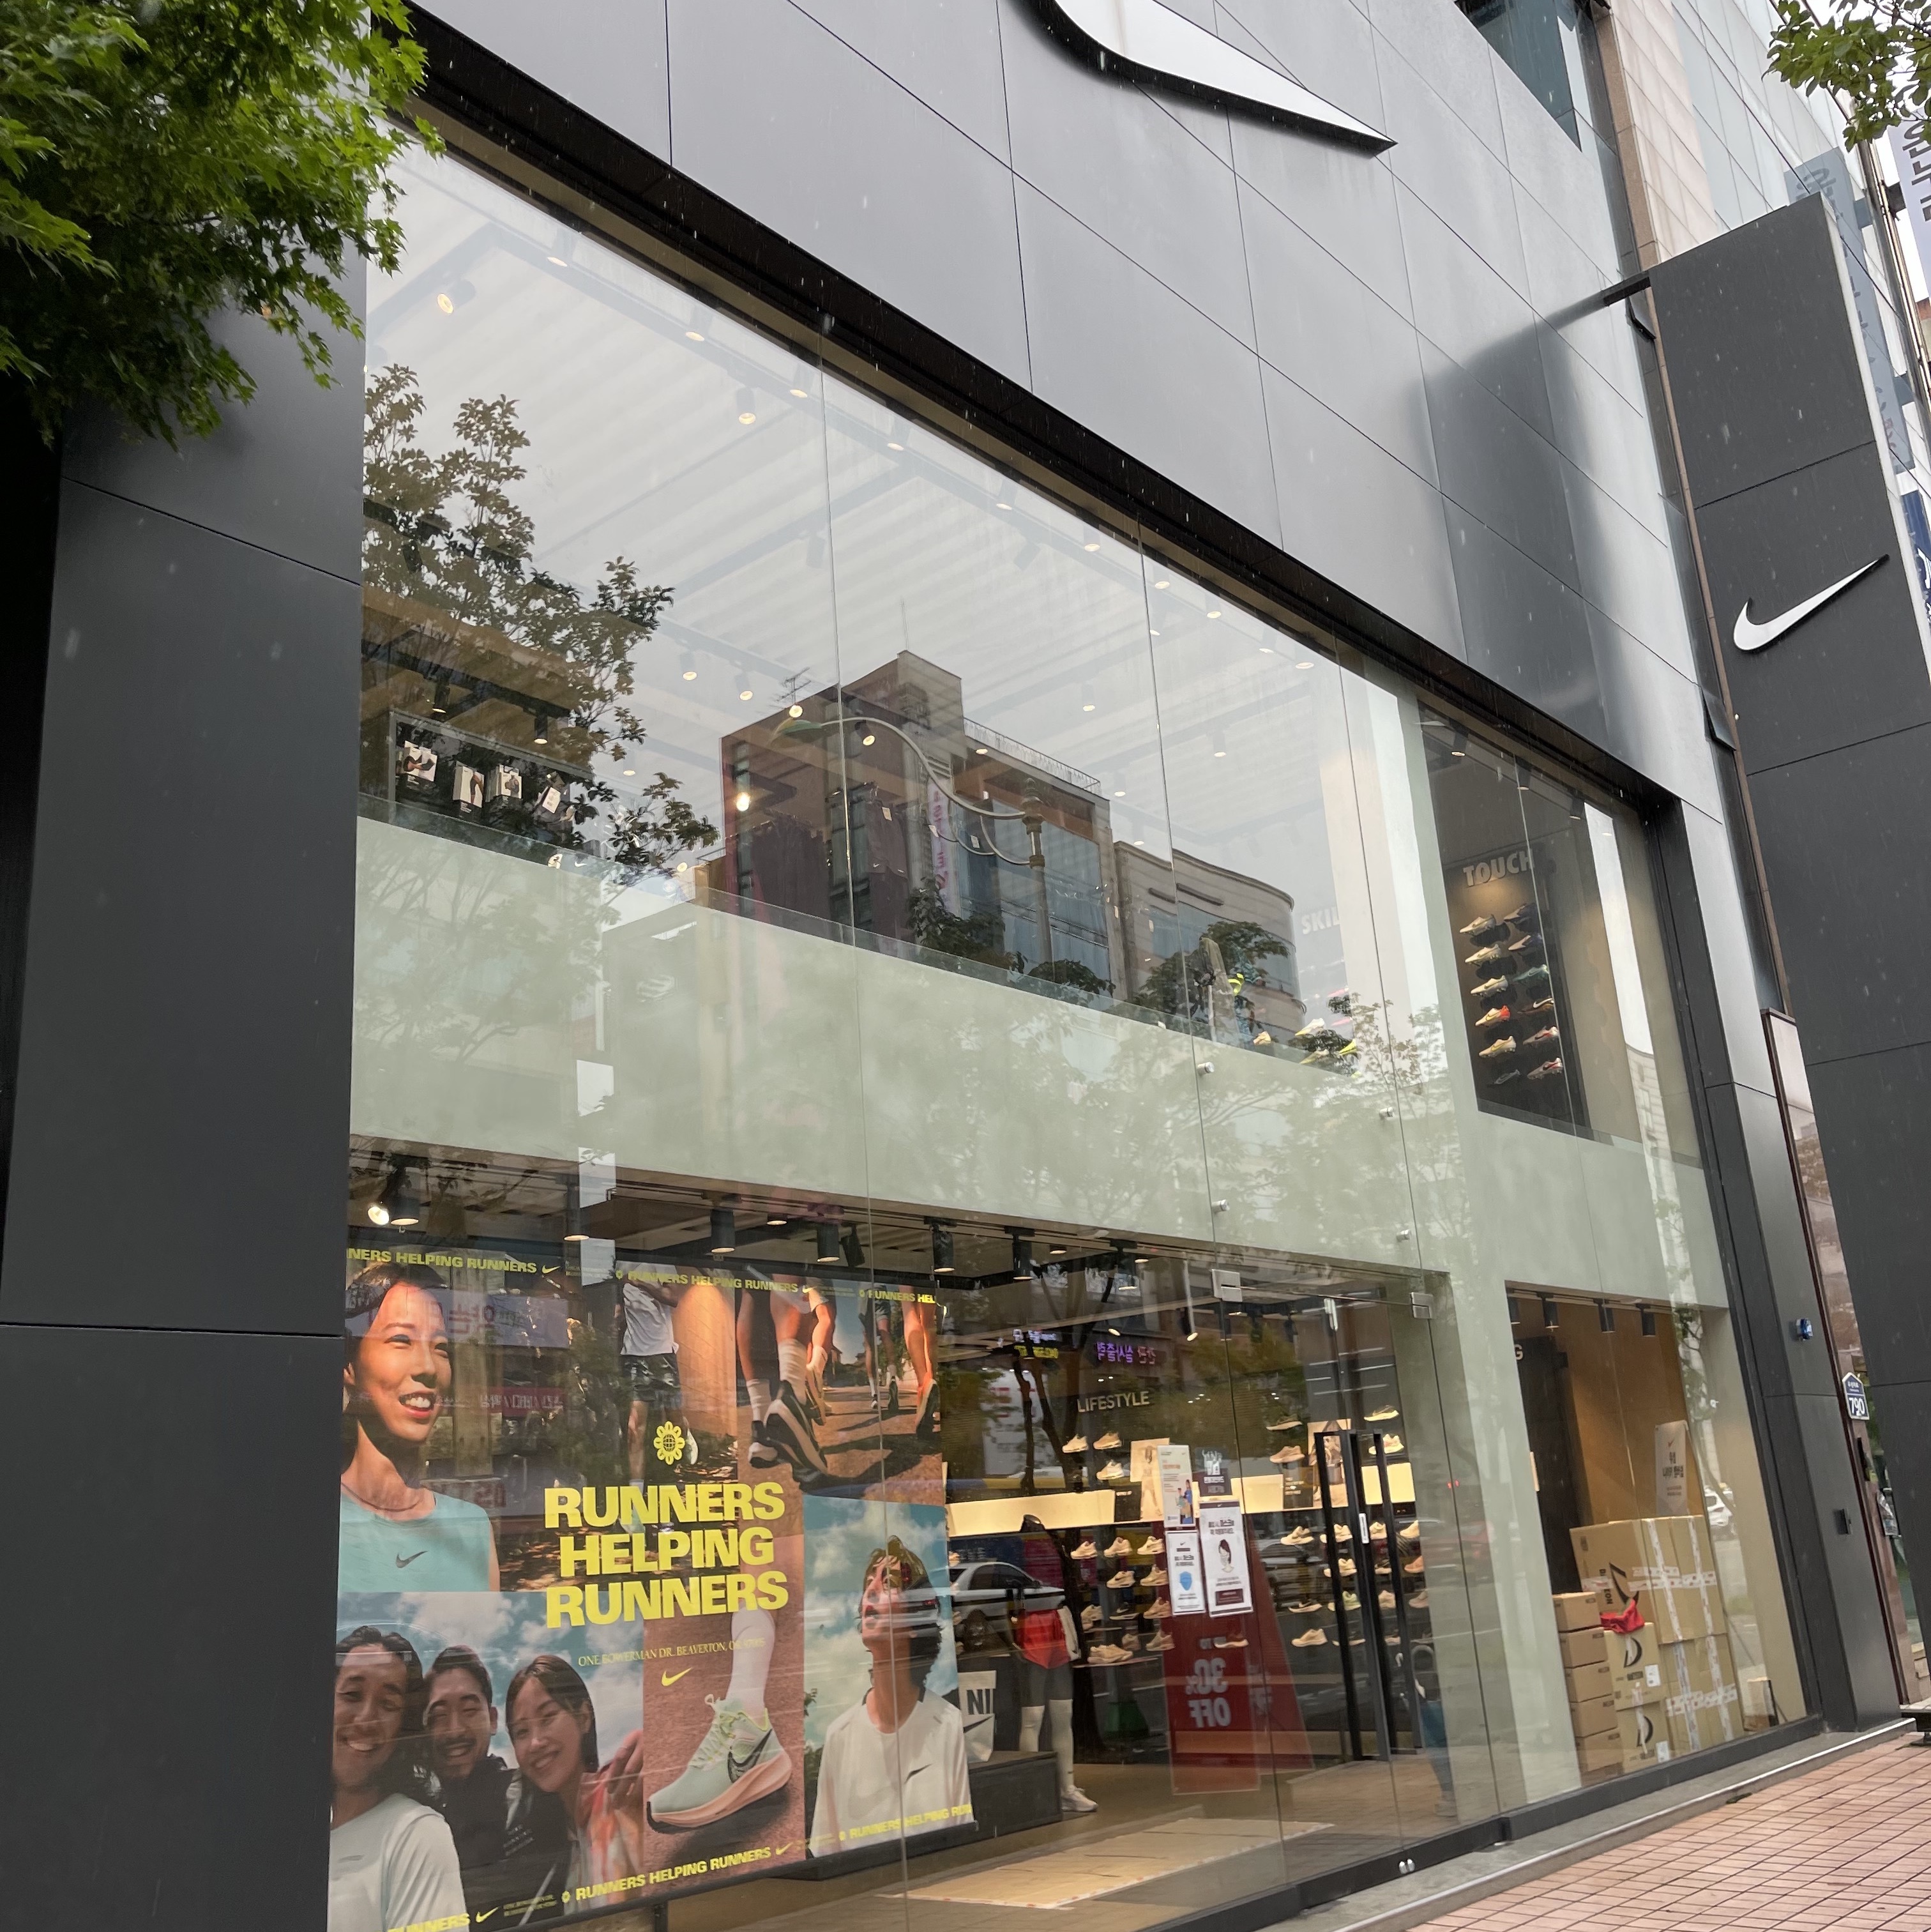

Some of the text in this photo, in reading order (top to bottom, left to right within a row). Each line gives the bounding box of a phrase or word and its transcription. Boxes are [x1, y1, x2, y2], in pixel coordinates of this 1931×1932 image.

[1463, 848, 1535, 886] TOUCH
[346, 1248, 537, 1274] NERS HELPING RUNNERS
[628, 1270, 798, 1293] RUNNERS HELPING RUNNERS
[868, 1289, 915, 1302] RUNNERS
[1077, 1391, 1150, 1412] LIFESTYLE
[1849, 1397, 1865, 1416] 790
[545, 1482, 785, 1528] RUNNERS
[560, 1526, 774, 1577] HELPING
[546, 1571, 789, 1629] RUNNERS
[578, 1655, 602, 1666] ONE
[849, 1818, 902, 1839] RUNNERS
[576, 1846, 771, 1901] RUNNERS HELPING RUNNERS
